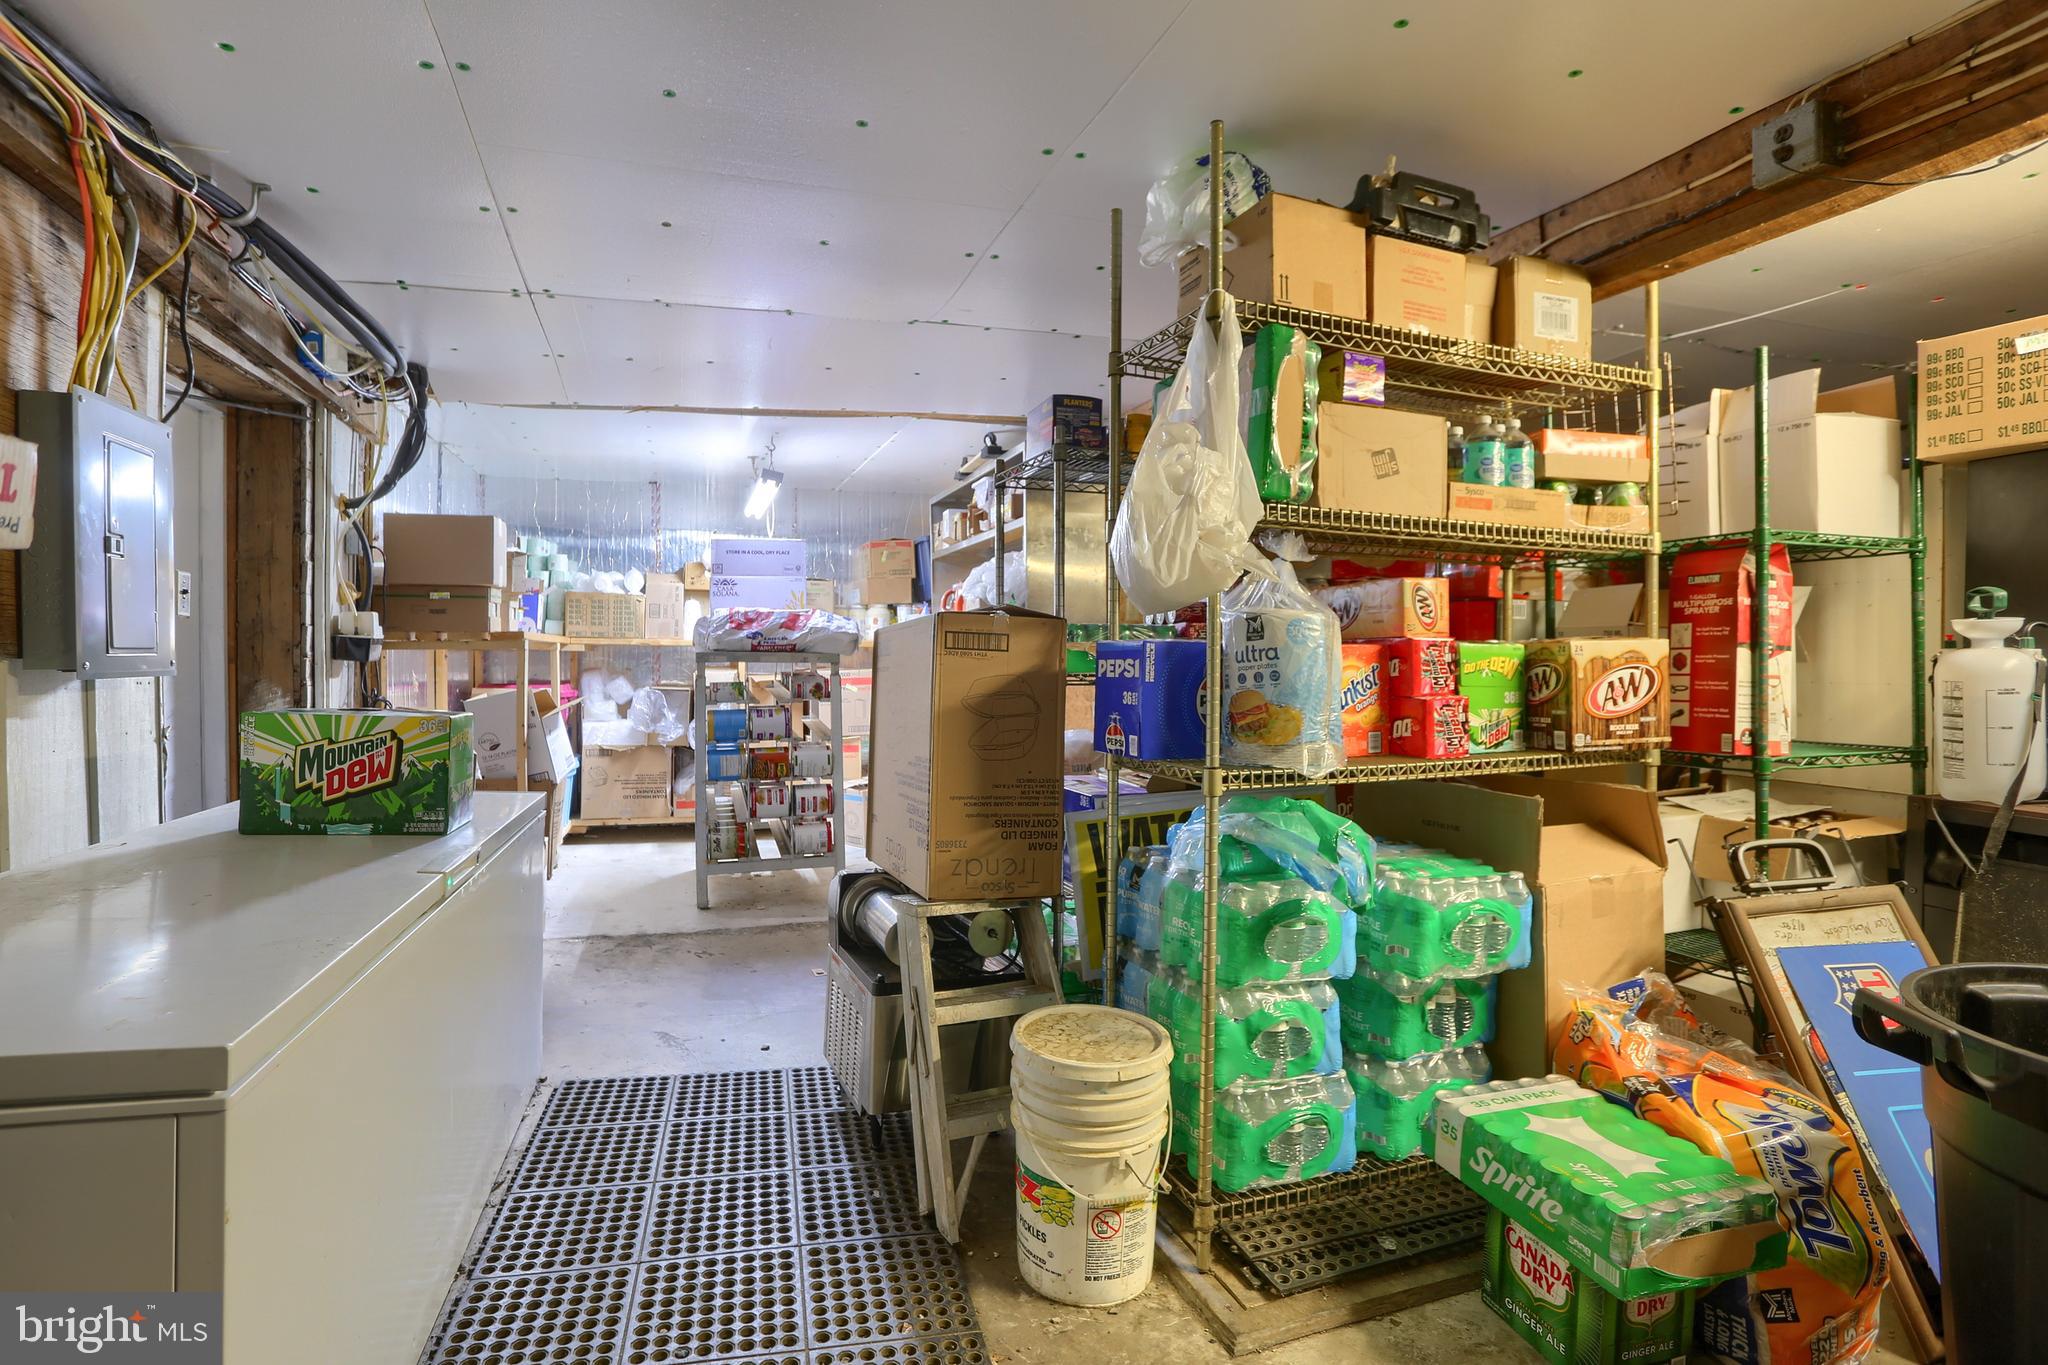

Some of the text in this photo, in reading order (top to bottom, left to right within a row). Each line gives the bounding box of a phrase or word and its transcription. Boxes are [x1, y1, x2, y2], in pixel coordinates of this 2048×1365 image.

[1927, 346, 1964, 366] 99c BBQ
[1997, 351, 2016, 364] 50c
[1927, 361, 1964, 380] 99c REG
[1997, 361, 2040, 380] 50c SCO
[1927, 375, 1964, 393] 99c SCO
[1997, 375, 2043, 394] 50c SS-V
[1927, 389, 1967, 407] 99c SS-V
[1997, 392, 2039, 410] 50c JAL
[1927, 405, 1963, 421] 99c JAL
[2022, 420, 2044, 436] BBQ
[1948, 432, 1966, 446] REG
[1673, 598, 1734, 608] MULTIPURPOSE
[1684, 606, 1720, 616] SPRAYER
[1235, 644, 1280, 664] ultra
[1574, 644, 1584, 652] 24
[1098, 658, 1140, 678] PEPSI
[1257, 662, 1278, 670] plates
[1464, 656, 1520, 680] DO THE DEW
[1528, 666, 1556, 698] A&W
[1602, 666, 1646, 712] A&W
[1122, 690, 1132, 705] 36
[1356, 693, 1378, 712] Orange
[1504, 691, 1516, 704] 36
[420, 719, 436, 733] 36
[1106, 736, 1124, 748] PEPSI
[993, 818, 1059, 829] CONTAINERS
[1000, 830, 1058, 840] HINGED LID
[1028, 842, 1058, 852] FOAM
[950, 857, 1040, 885] Trendz
[981, 880, 1016, 894] Sysco
[1470, 1088, 1562, 1108] 35 CAN PACK
[1440, 1120, 1458, 1141] 35
[1468, 1146, 1564, 1223] Sprite
[1569, 1162, 1618, 1188] Sprite
[1852, 1168, 1882, 1236] Absorbent
[1019, 1213, 1047, 1244] PICKLES
[1875, 1238, 1884, 1249] &
[1504, 1224, 1576, 1296] CANADA
[1520, 1256, 1556, 1298] DRY
[1637, 1296, 1668, 1317] DRY
[1504, 1298, 1566, 1356] GINGER ALE
[1703, 1302, 1715, 1346] LASTING
[1716, 1318, 1730, 1353] LONG
[1730, 1314, 1750, 1362] THICK
[1622, 1340, 1675, 1361] GINGER ALE
